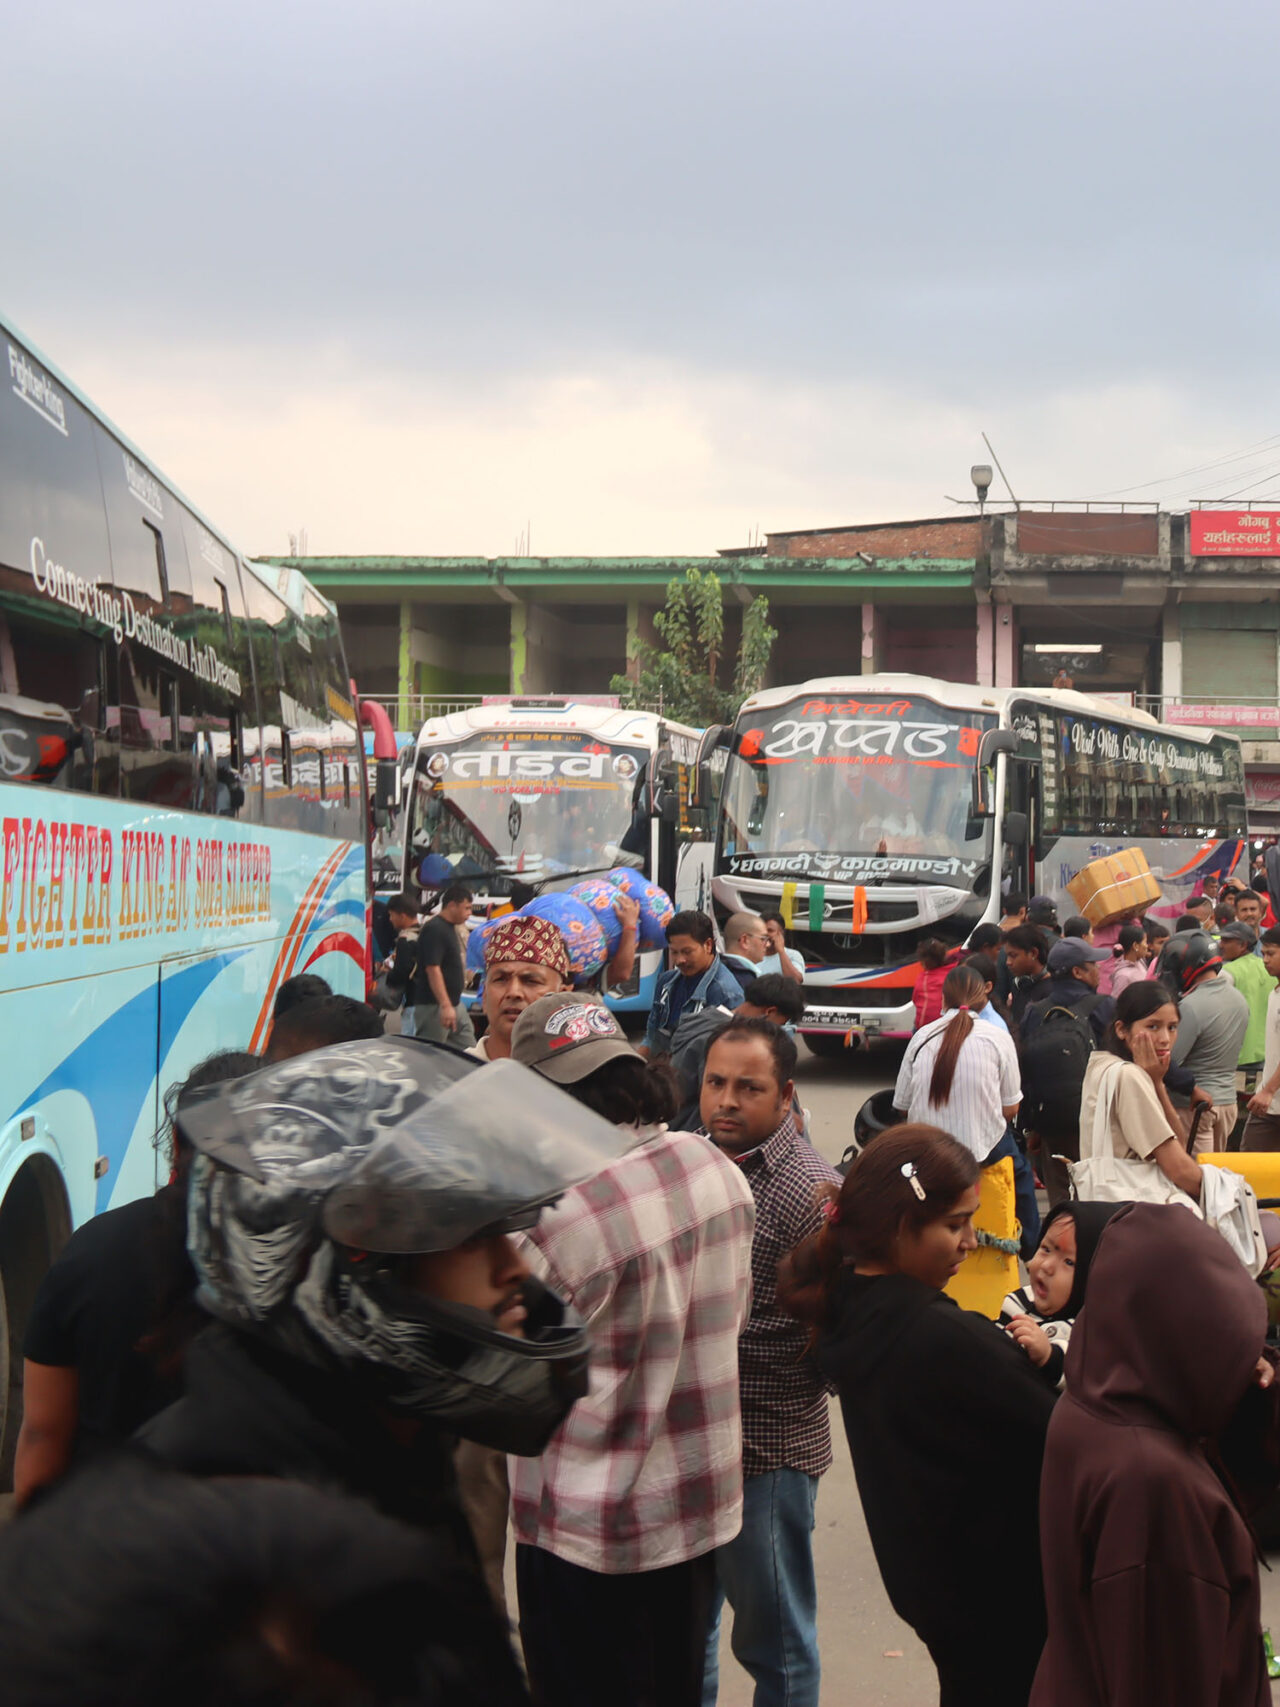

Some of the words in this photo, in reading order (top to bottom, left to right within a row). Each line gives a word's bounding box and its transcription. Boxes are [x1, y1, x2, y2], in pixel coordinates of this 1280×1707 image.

[31, 536, 123, 645] Connecting
[122, 591, 189, 670] Destination
[190, 635, 209, 680] And
[1072, 723, 1096, 755] Visit
[0, 817, 112, 954] FIGHTER
[119, 829, 164, 941] KING
[195, 838, 223, 928] SOFA
[226, 842, 271, 926] SLEEPER
